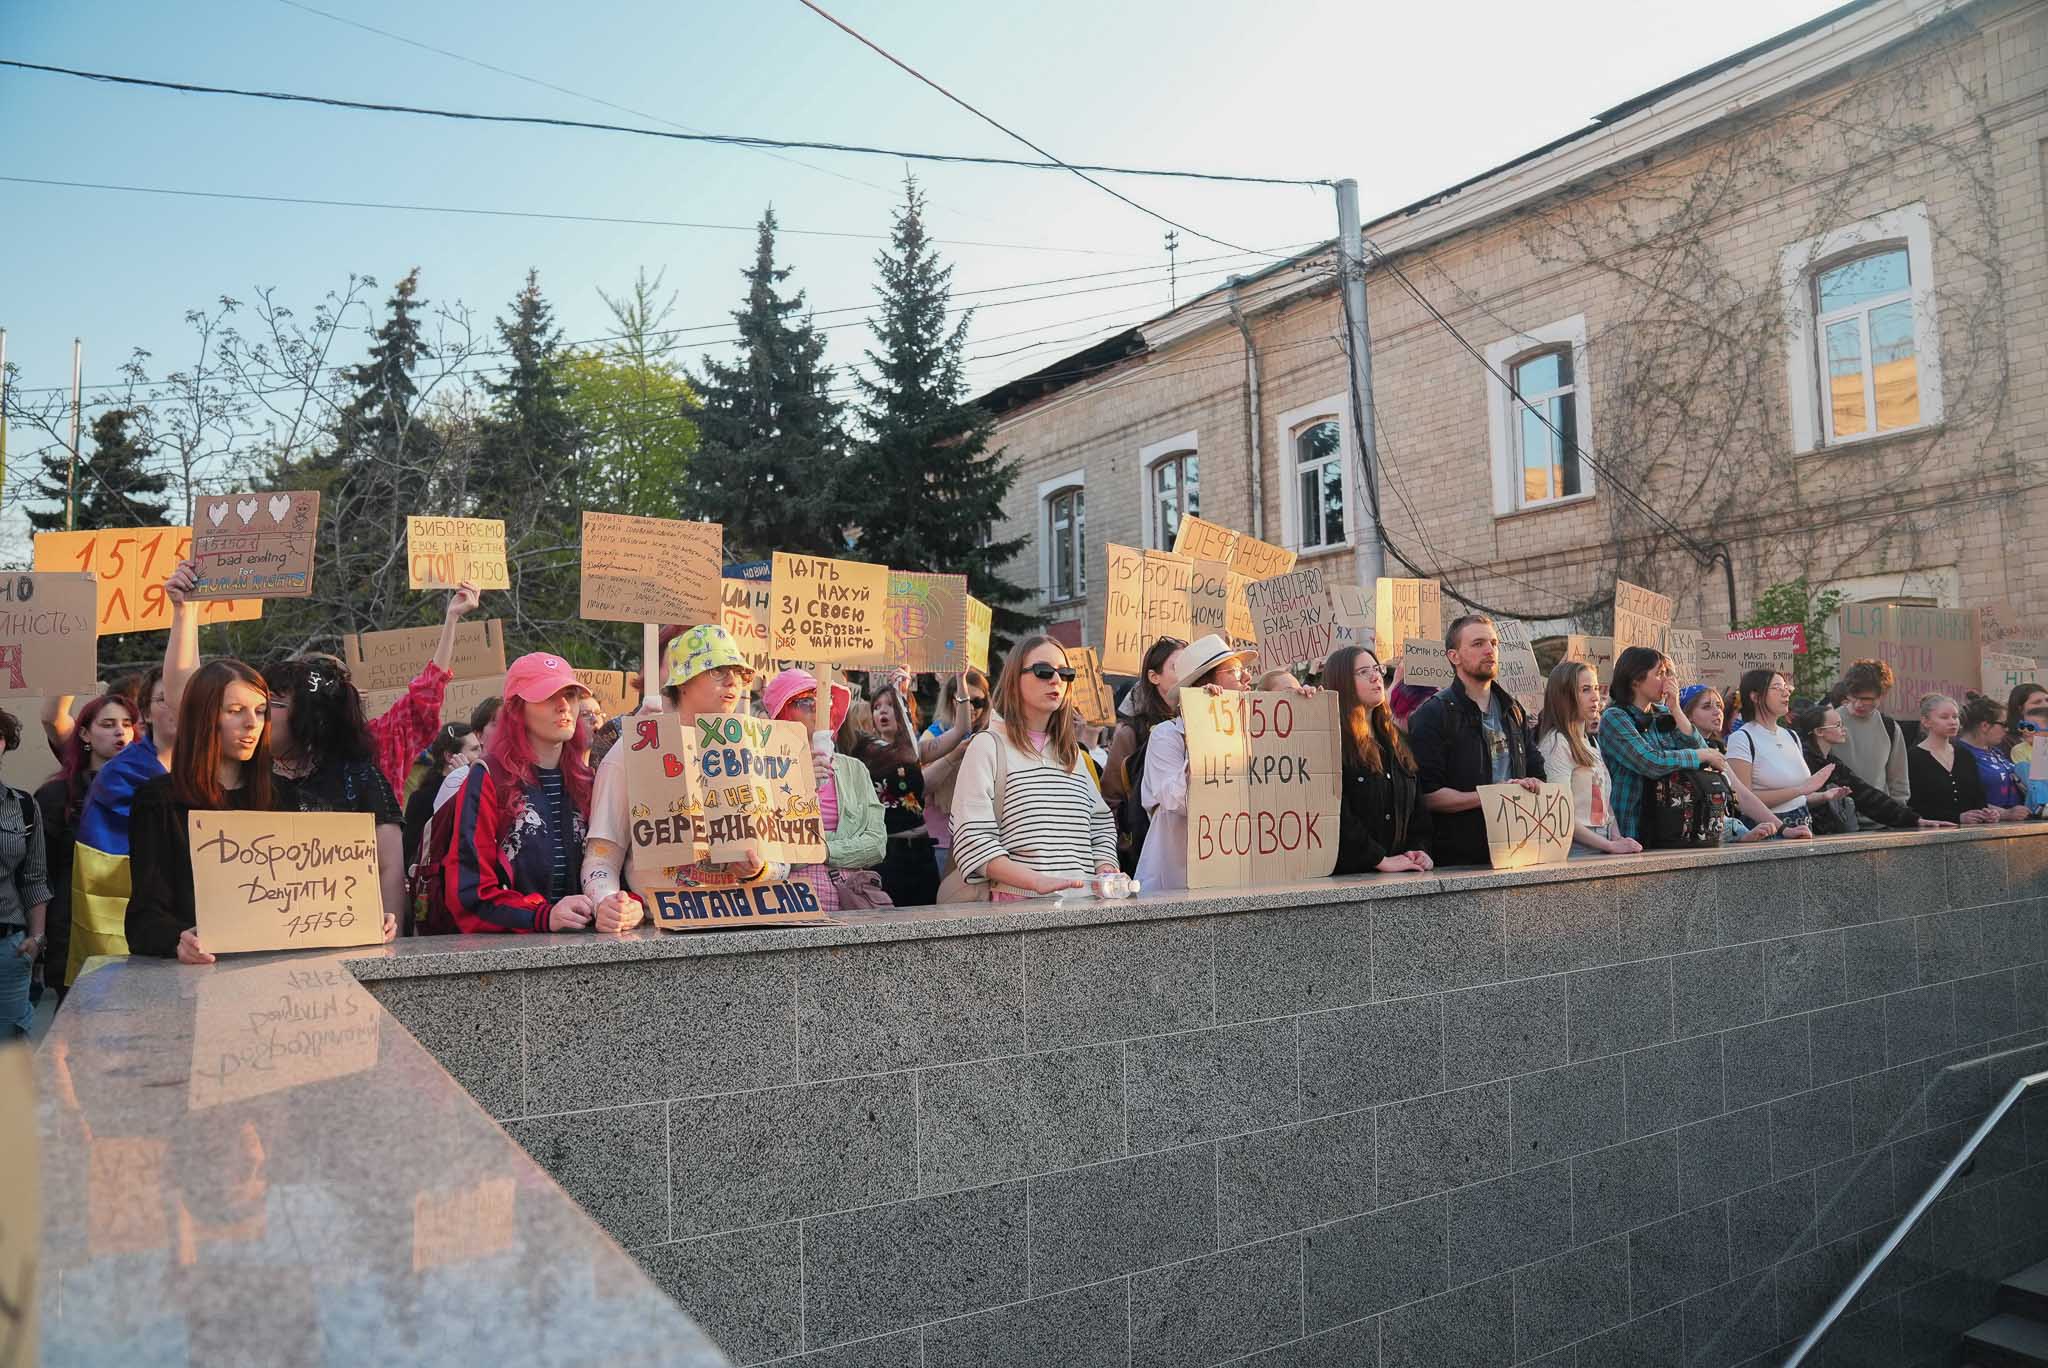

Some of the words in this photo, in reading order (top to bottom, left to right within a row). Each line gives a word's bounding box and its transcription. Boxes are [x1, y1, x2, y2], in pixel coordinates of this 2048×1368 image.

[75, 533, 193, 580] 1515
[217, 554, 242, 567] bad
[247, 548, 287, 571] ending
[412, 552, 455, 585] СТОП
[788, 557, 840, 581] ІДІТЬ
[1110, 555, 1169, 587] 15150
[817, 583, 870, 601] НАХУЙ
[1265, 596, 1313, 617] ЛЮБИТИ
[781, 595, 800, 615] ЗІ
[807, 599, 865, 623] СВОЄЮ
[1263, 606, 1321, 635] БУДЬ-ЯКУ
[809, 635, 874, 650] ЧАЙНІСТЮ
[1263, 622, 1332, 670] ЛЮДИНУ
[631, 719, 660, 751] Я
[696, 717, 772, 749] ХОЧУ
[1208, 698, 1293, 739] 15150
[701, 748, 792, 780] ЄВРОПУ
[1204, 753, 1234, 789] ЦЕ
[1248, 754, 1311, 786] КРОК
[724, 784, 753, 807] НЕ
[632, 812, 822, 848] СЕРЕДНЬОВІЧЧЯ
[1496, 793, 1571, 849] 15150
[654, 887, 753, 921] БАГАТО
[751, 880, 820, 916] СЛІВ
[281, 911, 357, 938] 15150
